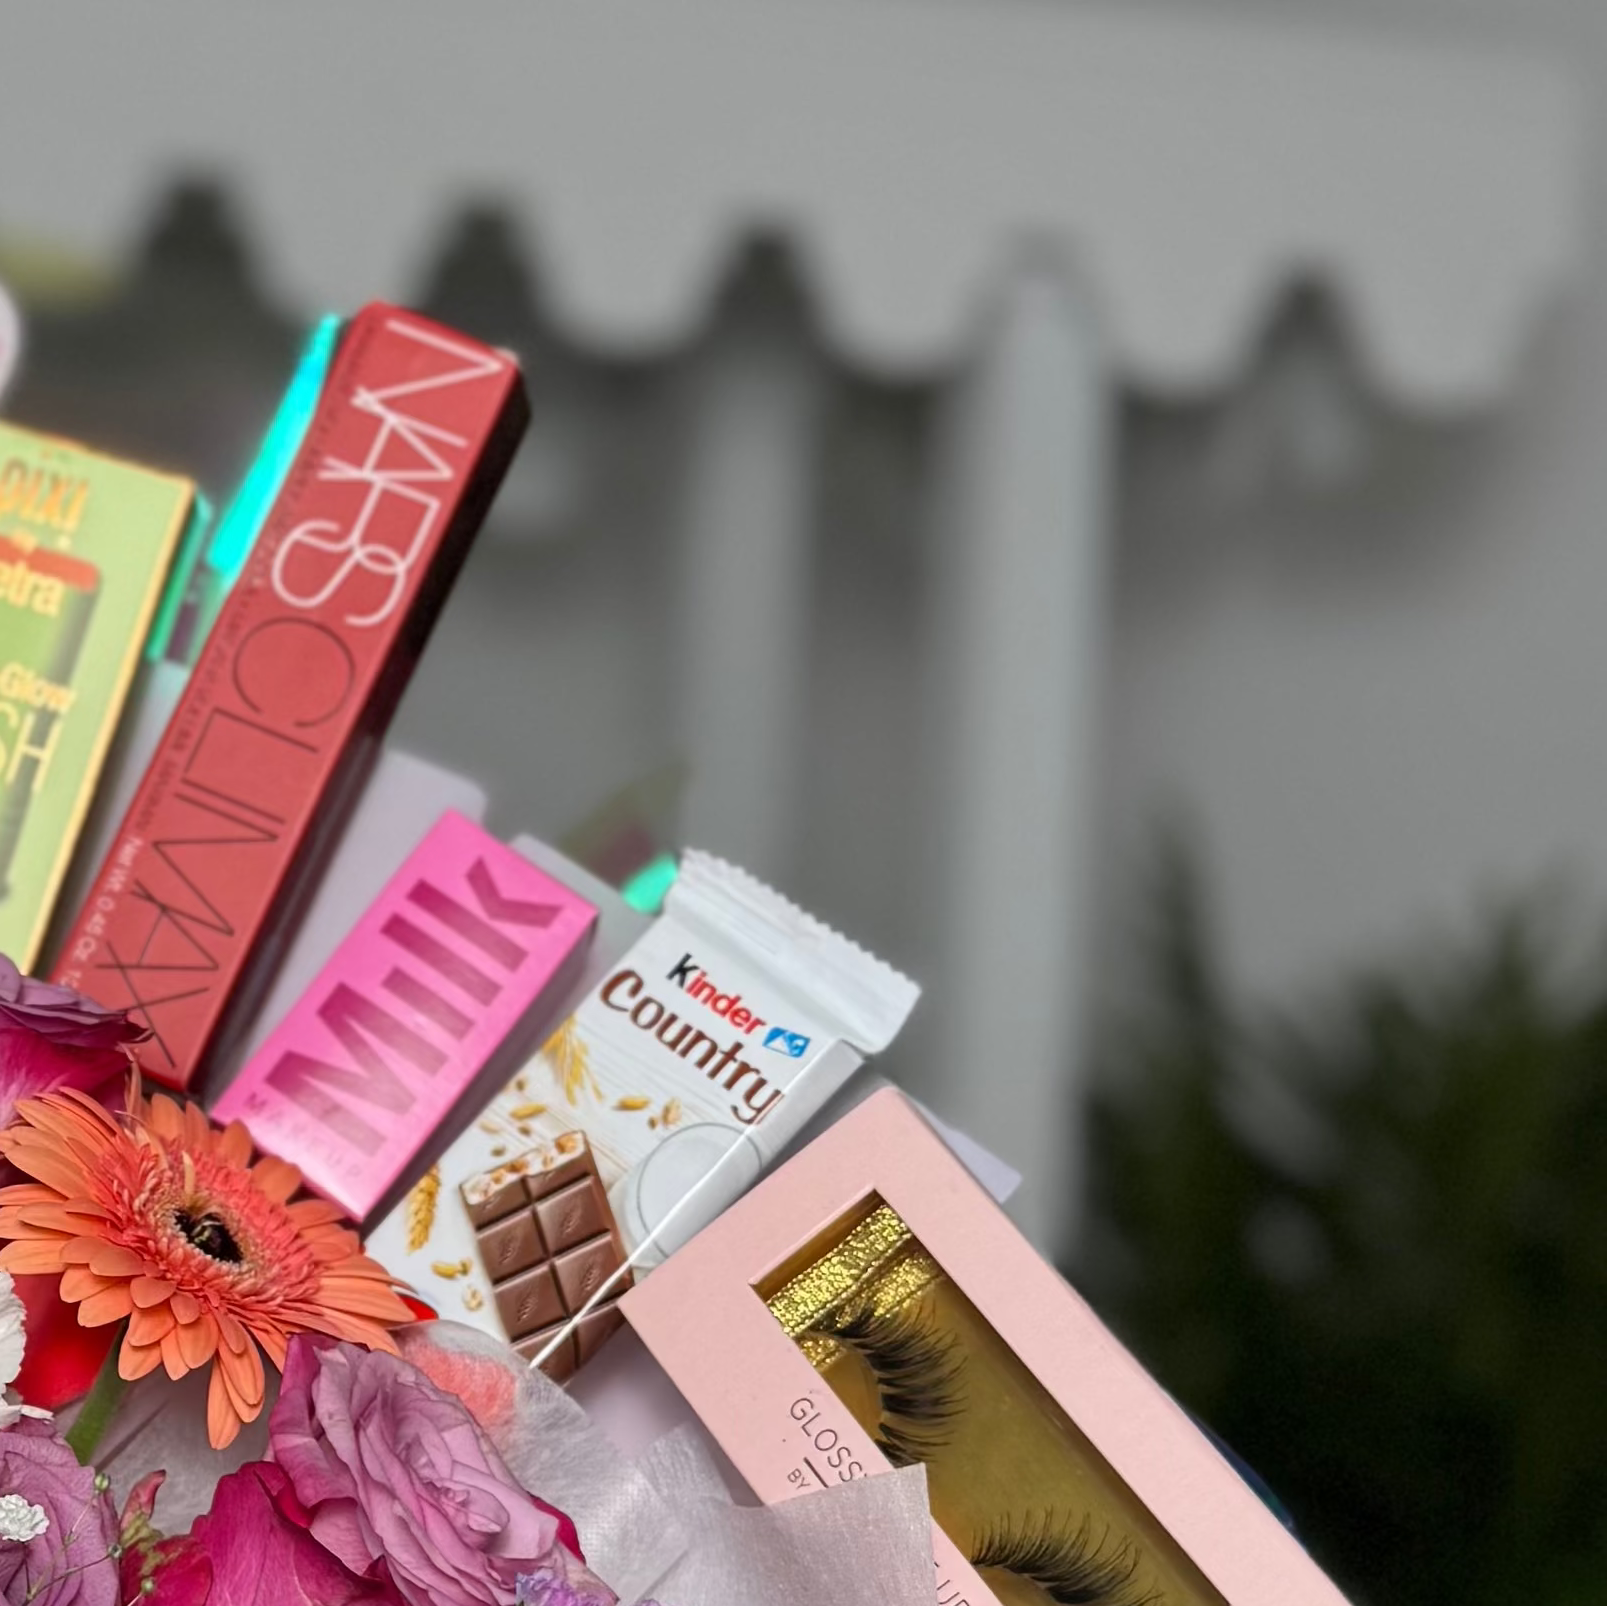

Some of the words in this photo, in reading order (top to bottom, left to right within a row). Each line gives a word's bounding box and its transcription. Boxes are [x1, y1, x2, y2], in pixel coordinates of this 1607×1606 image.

[273, 320, 505, 627] NARS
[95, 615, 356, 1070] CLIMAX
[598, 969, 785, 1125] Country
[665, 952, 766, 1038] Kinder
[786, 1467, 811, 1491] BY
[789, 1396, 868, 1483] GLOSS
